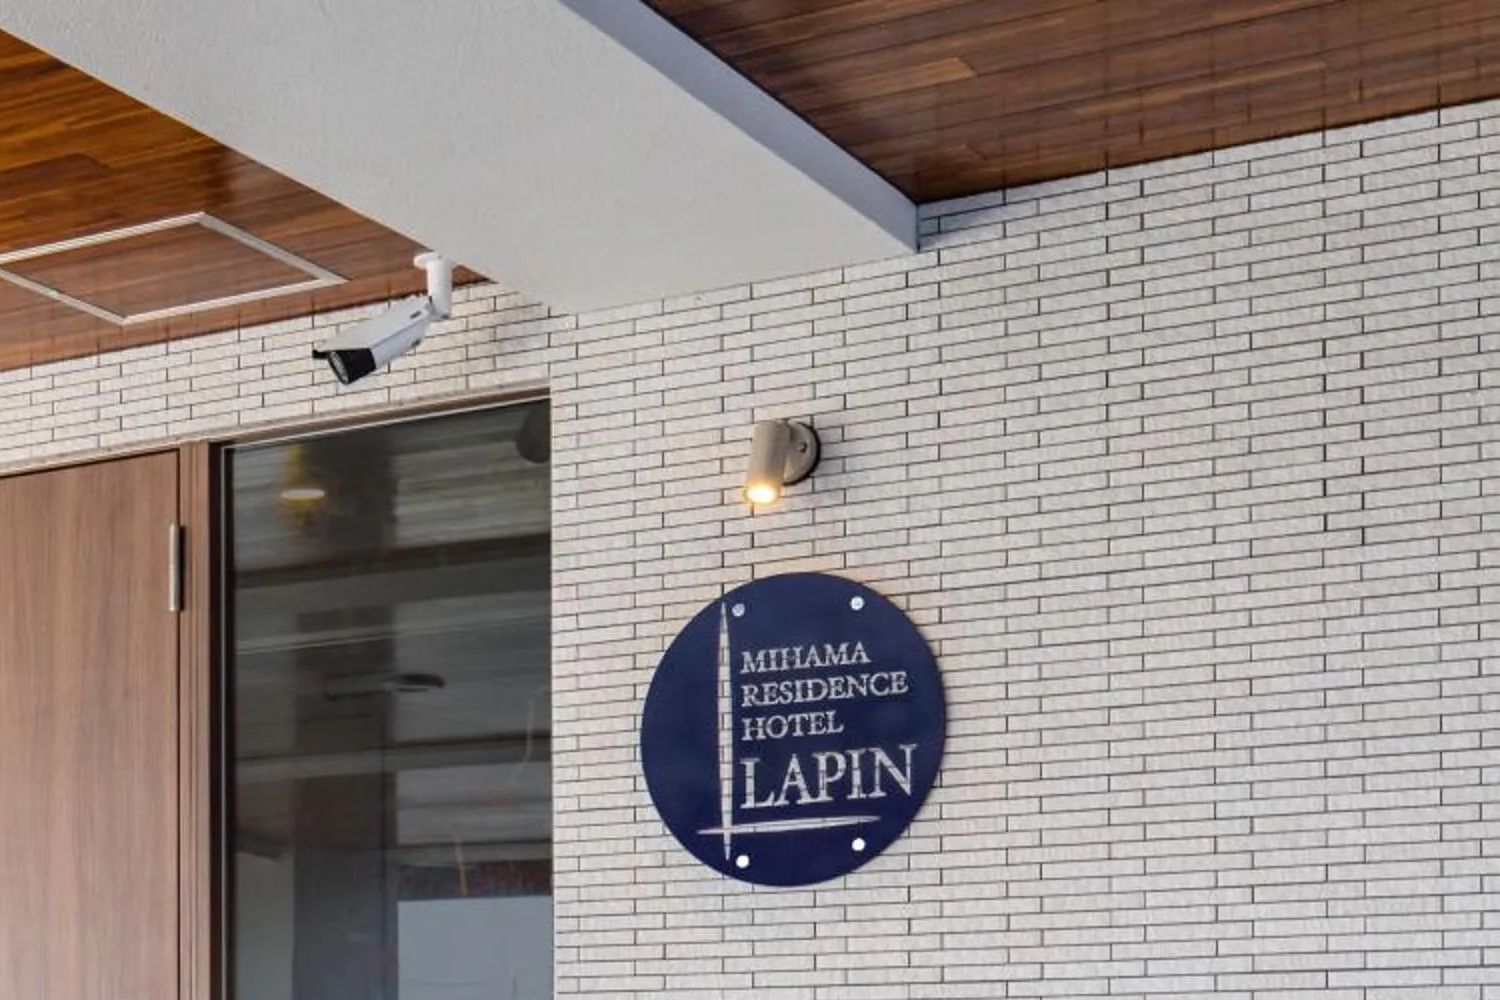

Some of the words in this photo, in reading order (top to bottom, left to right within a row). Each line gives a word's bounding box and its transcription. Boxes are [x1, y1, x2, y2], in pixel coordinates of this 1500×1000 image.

[740, 641, 870, 674] MIHAMA
[741, 671, 908, 707] RESIDENCE
[741, 710, 844, 741] HOTEL
[740, 743, 917, 809] LAPIN
